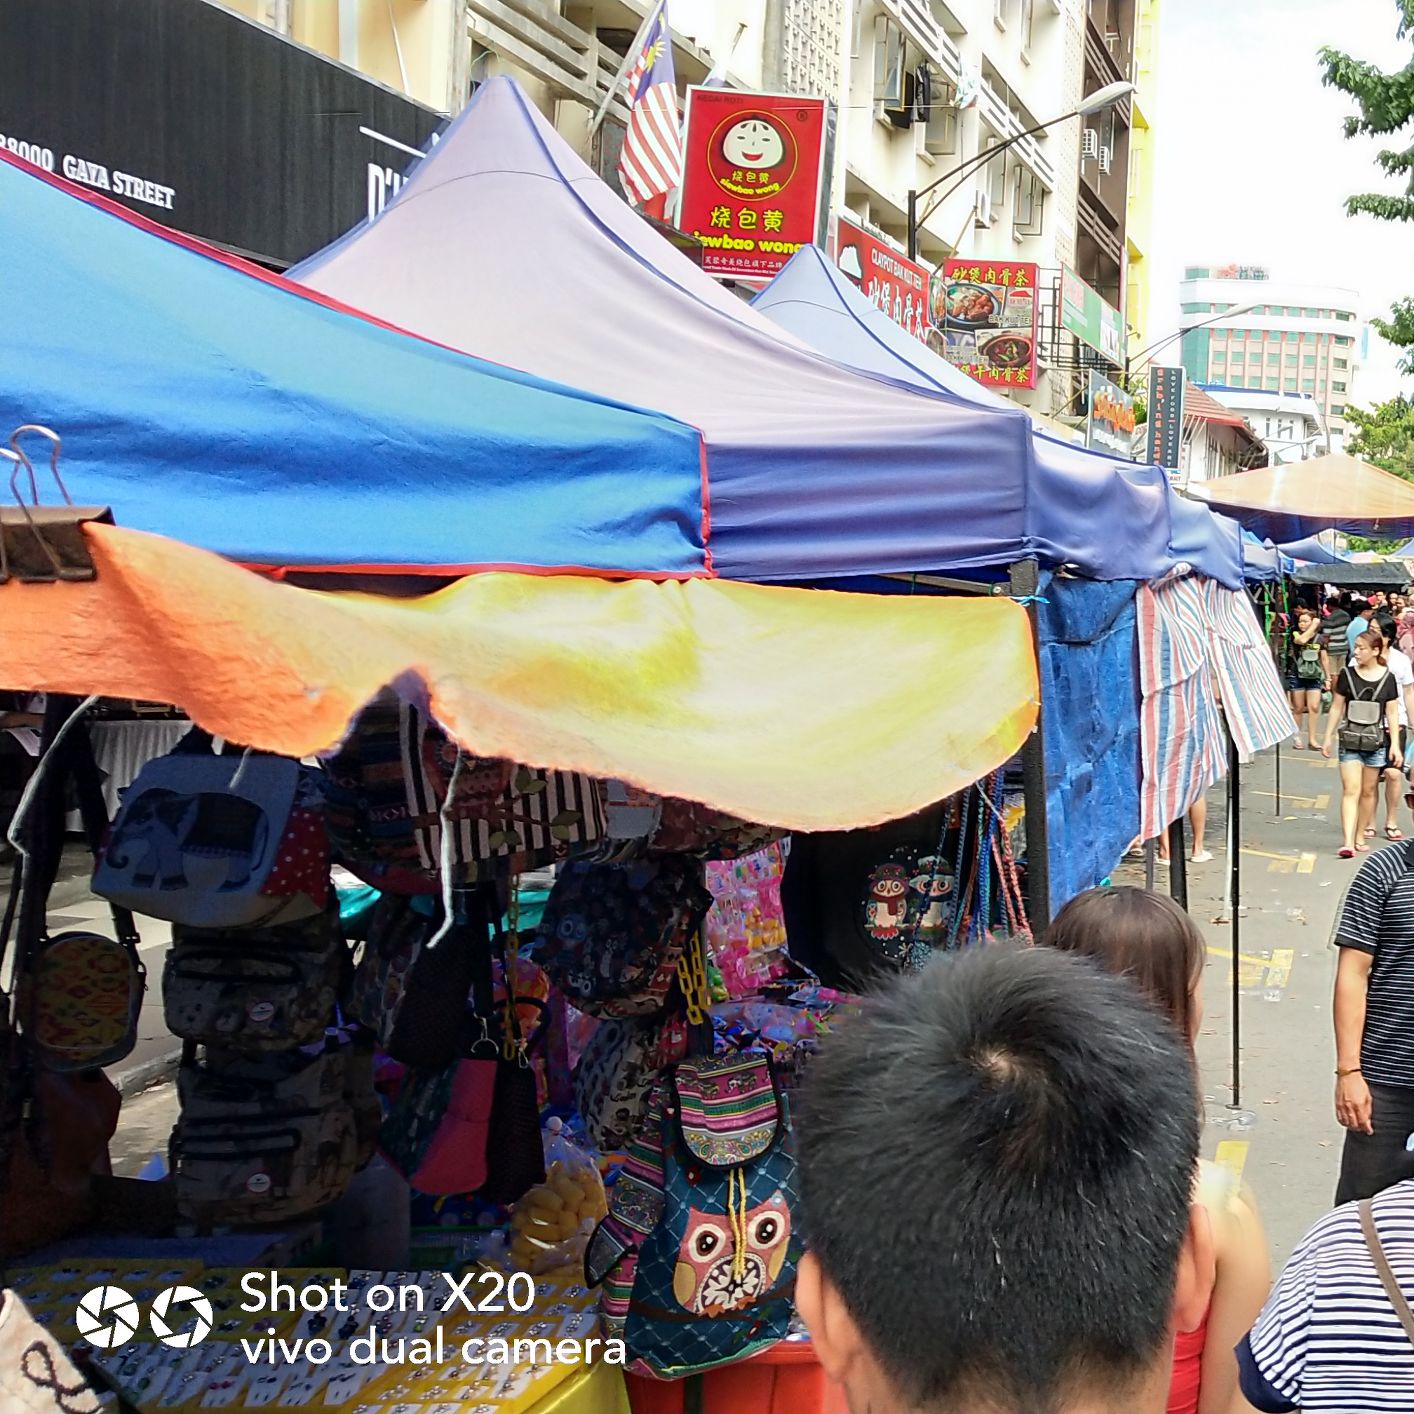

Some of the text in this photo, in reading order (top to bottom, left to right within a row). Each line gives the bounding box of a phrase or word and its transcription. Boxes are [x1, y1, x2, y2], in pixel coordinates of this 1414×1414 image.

[63, 154, 111, 191] GAYA
[112, 170, 175, 210] STREET
[719, 178, 780, 195] siewbao wong
[732, 170, 770, 184] 烧包黄
[710, 206, 784, 232] 烧包黄
[871, 247, 894, 274] CLAYPOT
[893, 261, 904, 281] BAK
[913, 272, 923, 291] TEH
[951, 266, 1030, 288] 砂煲肉骨茶
